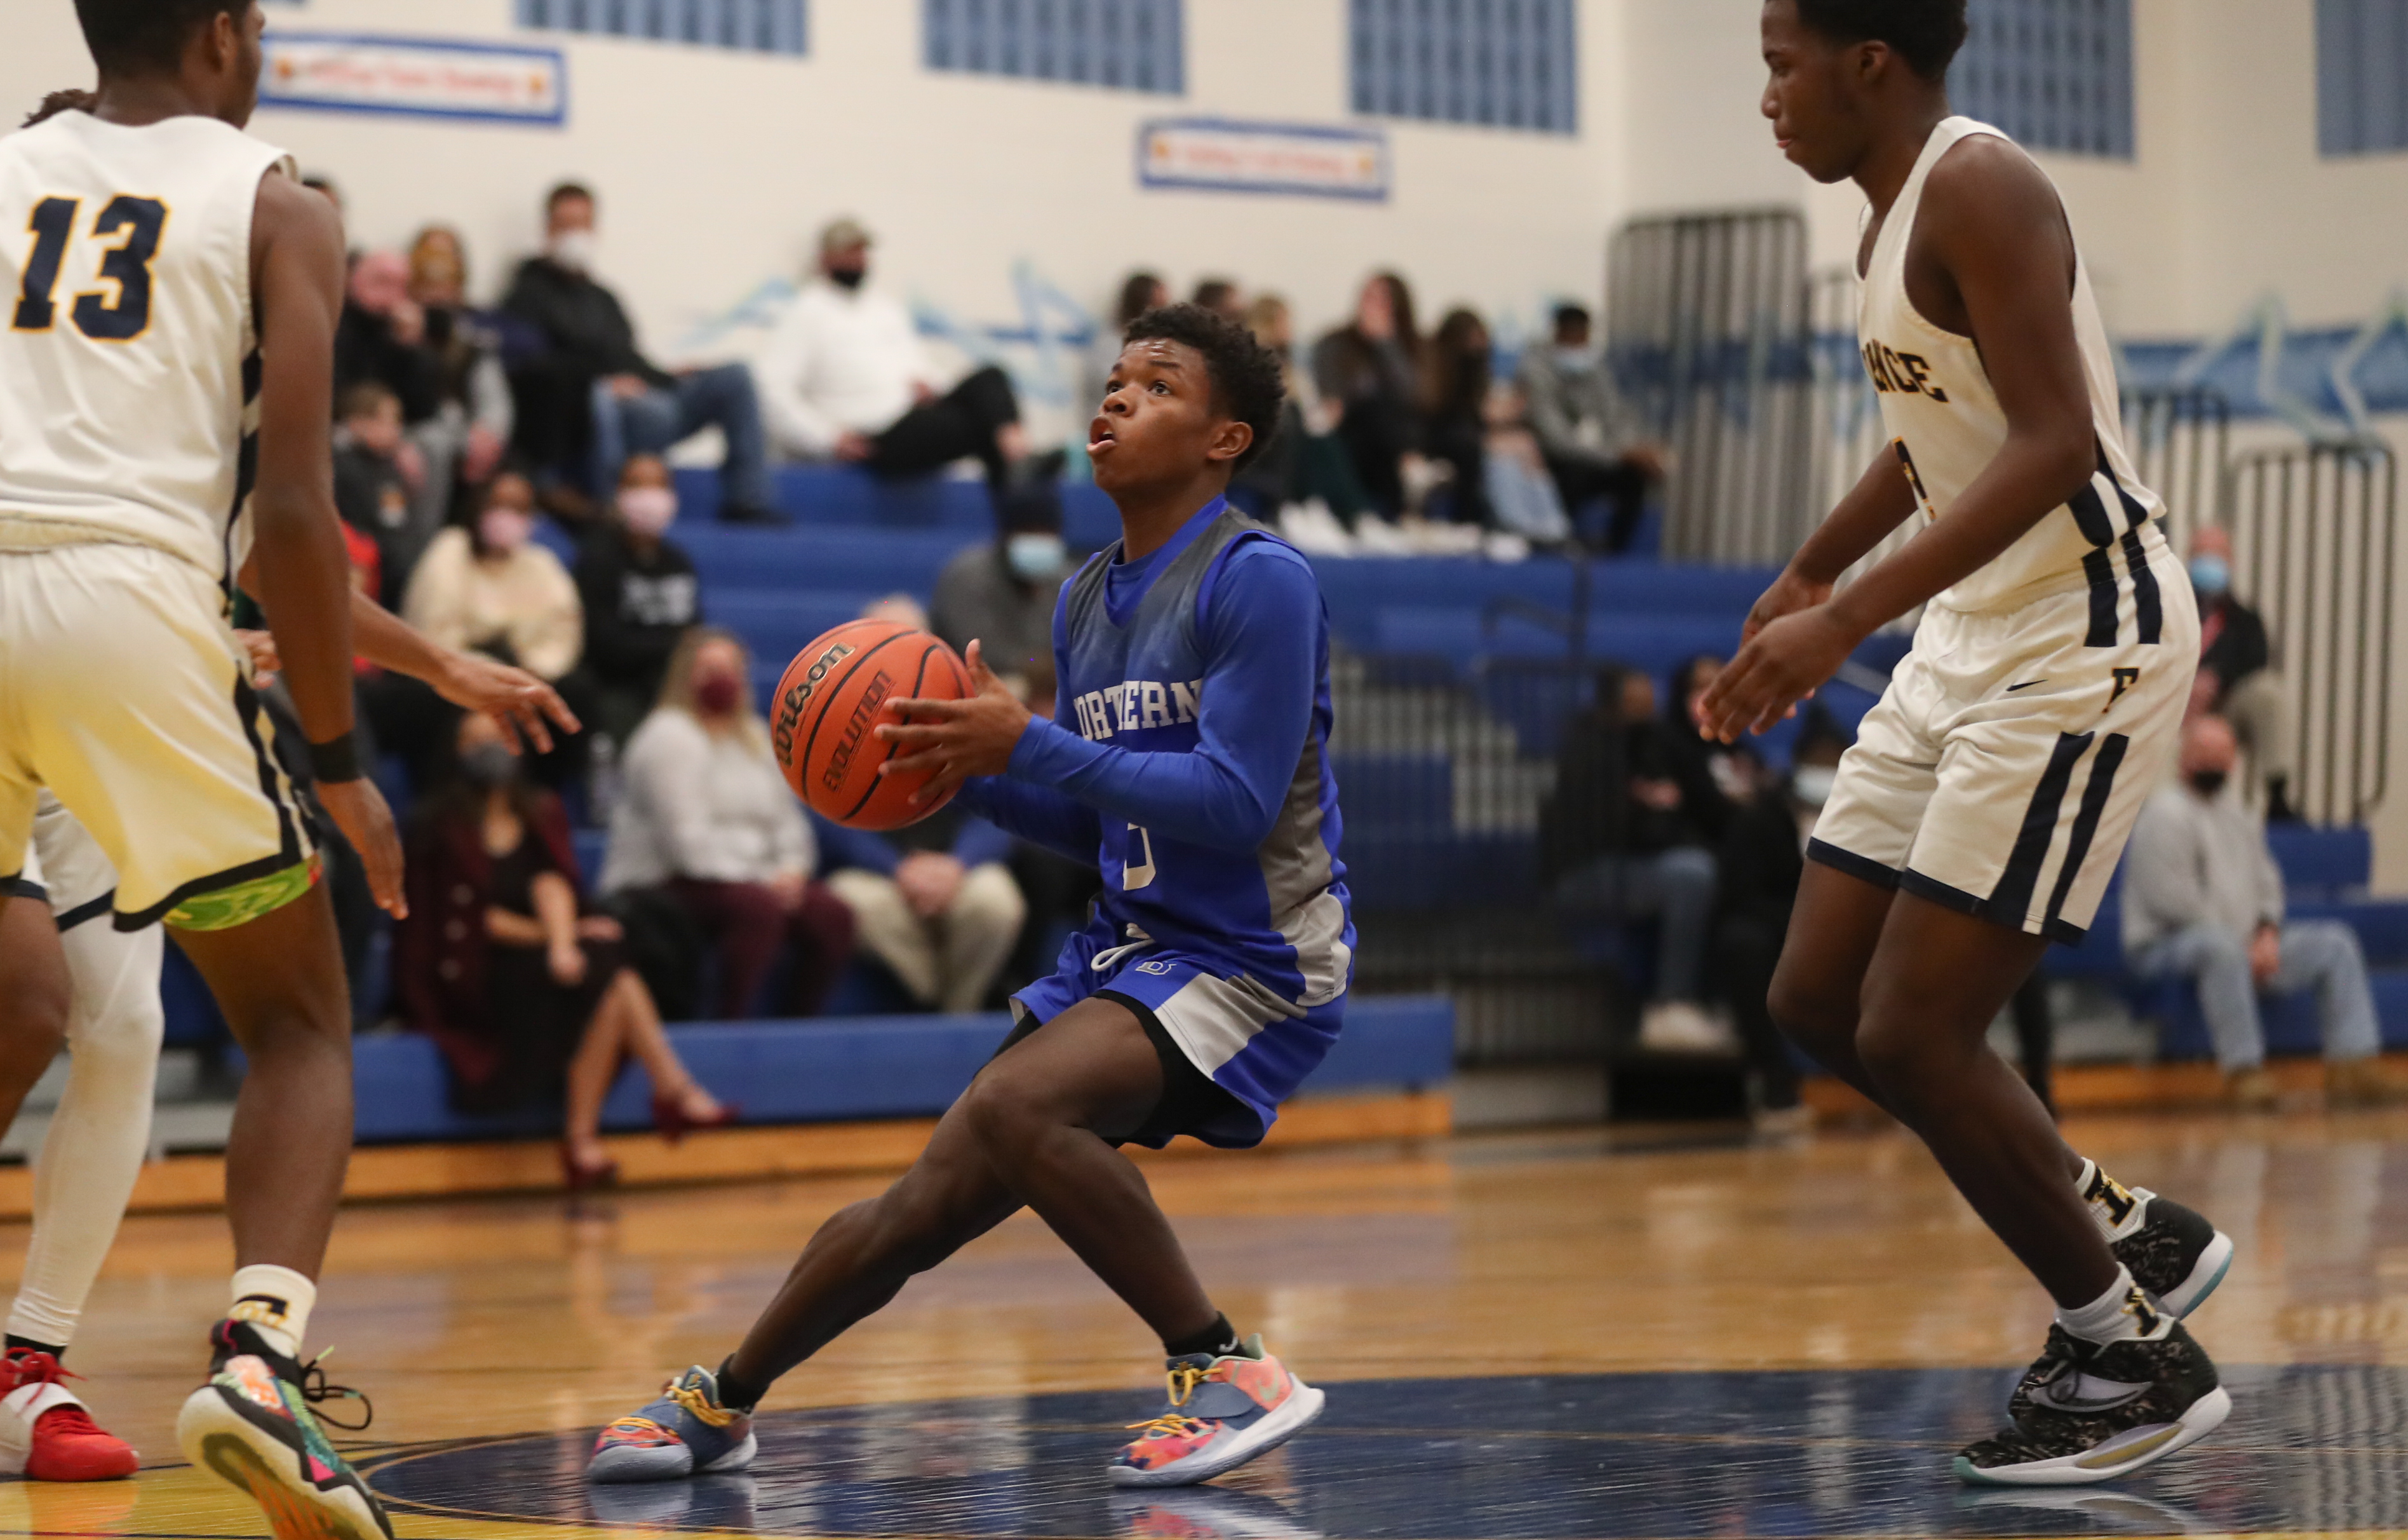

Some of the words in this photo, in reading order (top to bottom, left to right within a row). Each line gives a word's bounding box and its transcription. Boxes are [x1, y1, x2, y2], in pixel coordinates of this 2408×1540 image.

[9, 192, 173, 344] 13
[1860, 338, 1949, 403] NCE
[774, 640, 856, 769] Wilson
[823, 669, 893, 794] EVOLUTION
